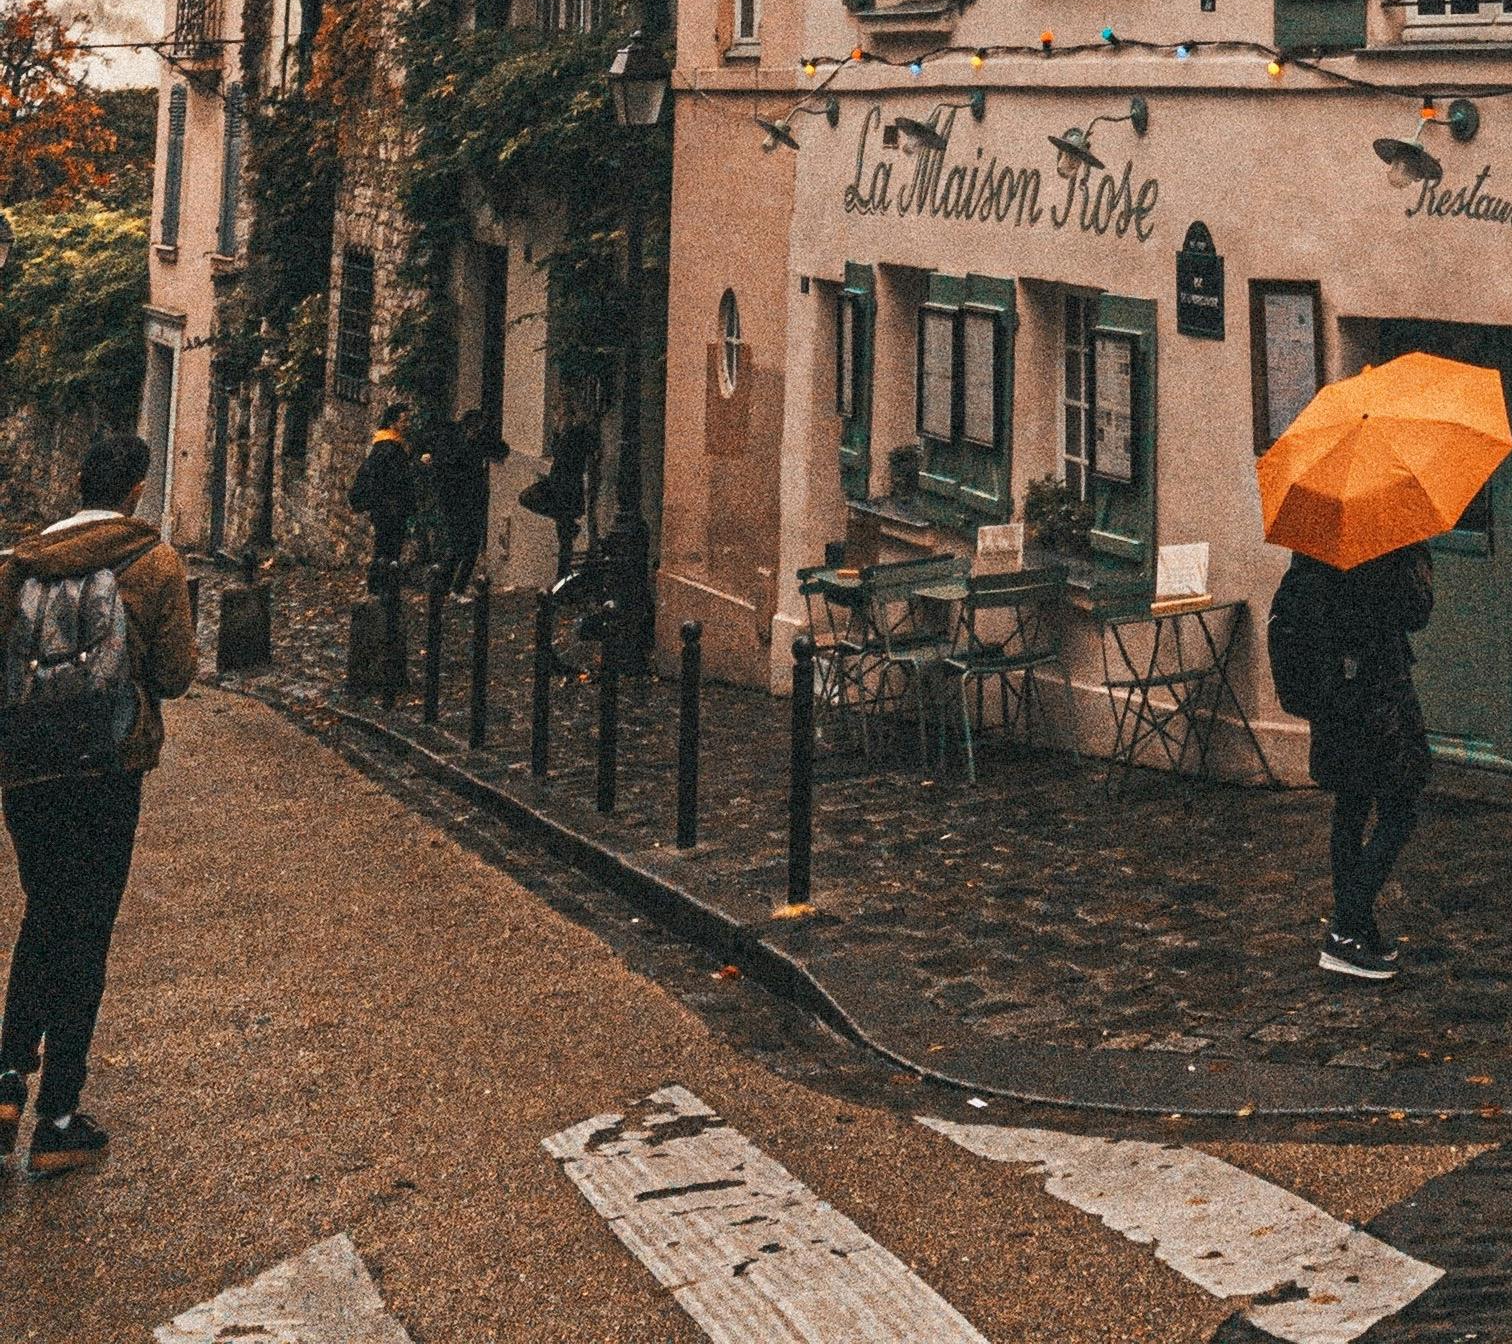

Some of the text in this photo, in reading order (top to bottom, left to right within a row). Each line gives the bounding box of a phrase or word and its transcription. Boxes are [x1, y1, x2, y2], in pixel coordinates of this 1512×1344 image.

[845, 106, 1159, 243] La Maison Rose
